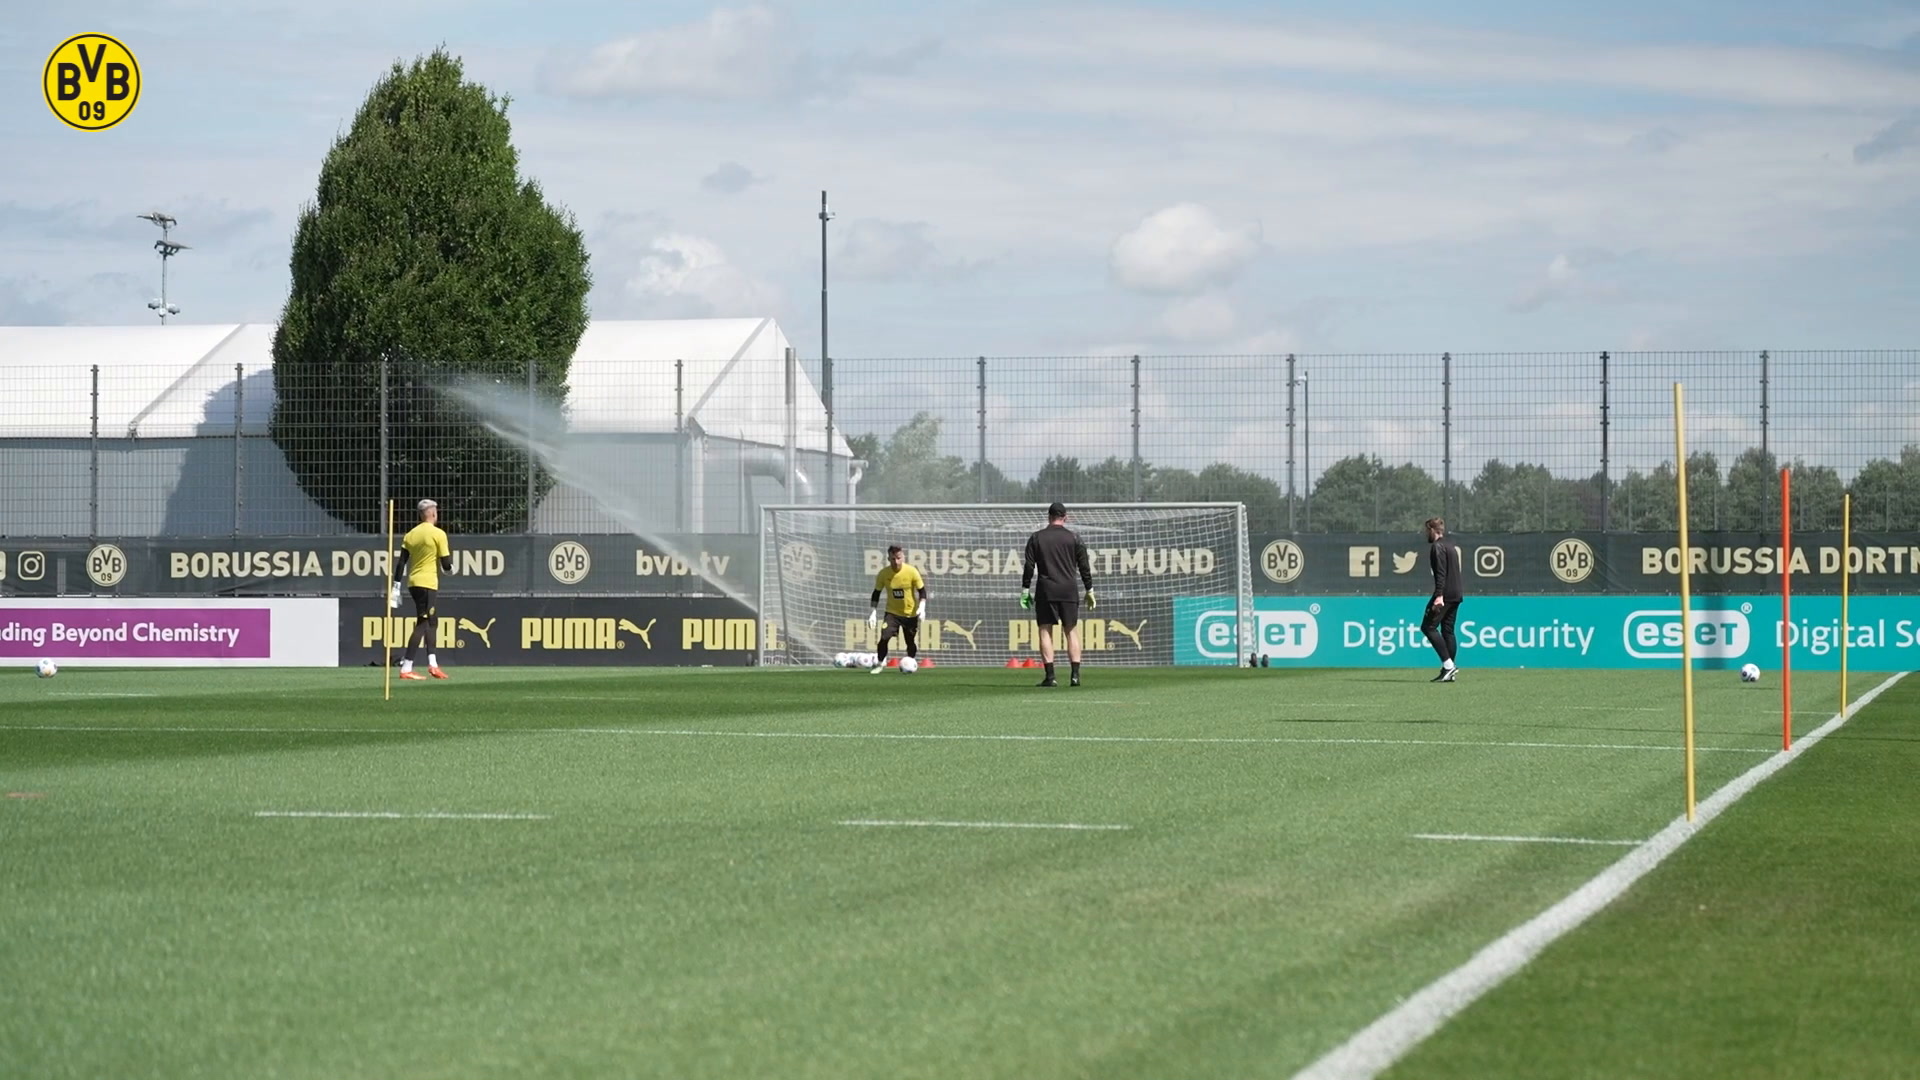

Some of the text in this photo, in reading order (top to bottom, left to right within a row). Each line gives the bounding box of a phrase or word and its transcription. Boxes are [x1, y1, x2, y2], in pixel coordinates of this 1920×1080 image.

[92, 550, 123, 574] BVB
[170, 550, 505, 578] BORUSSIA DORUND
[555, 547, 586, 572] BVB
[863, 547, 1215, 576] BRUSSIA RTMUND
[1267, 544, 1298, 570] BVB
[1557, 543, 1589, 568] BVB
[1642, 546, 1811, 574] BORUSSIA
[0, 622, 240, 648] ding Beyond Chemistry
[521, 617, 616, 650] PUMA
[1343, 618, 1596, 656] Digit Security
[1776, 618, 1885, 656] Digital
